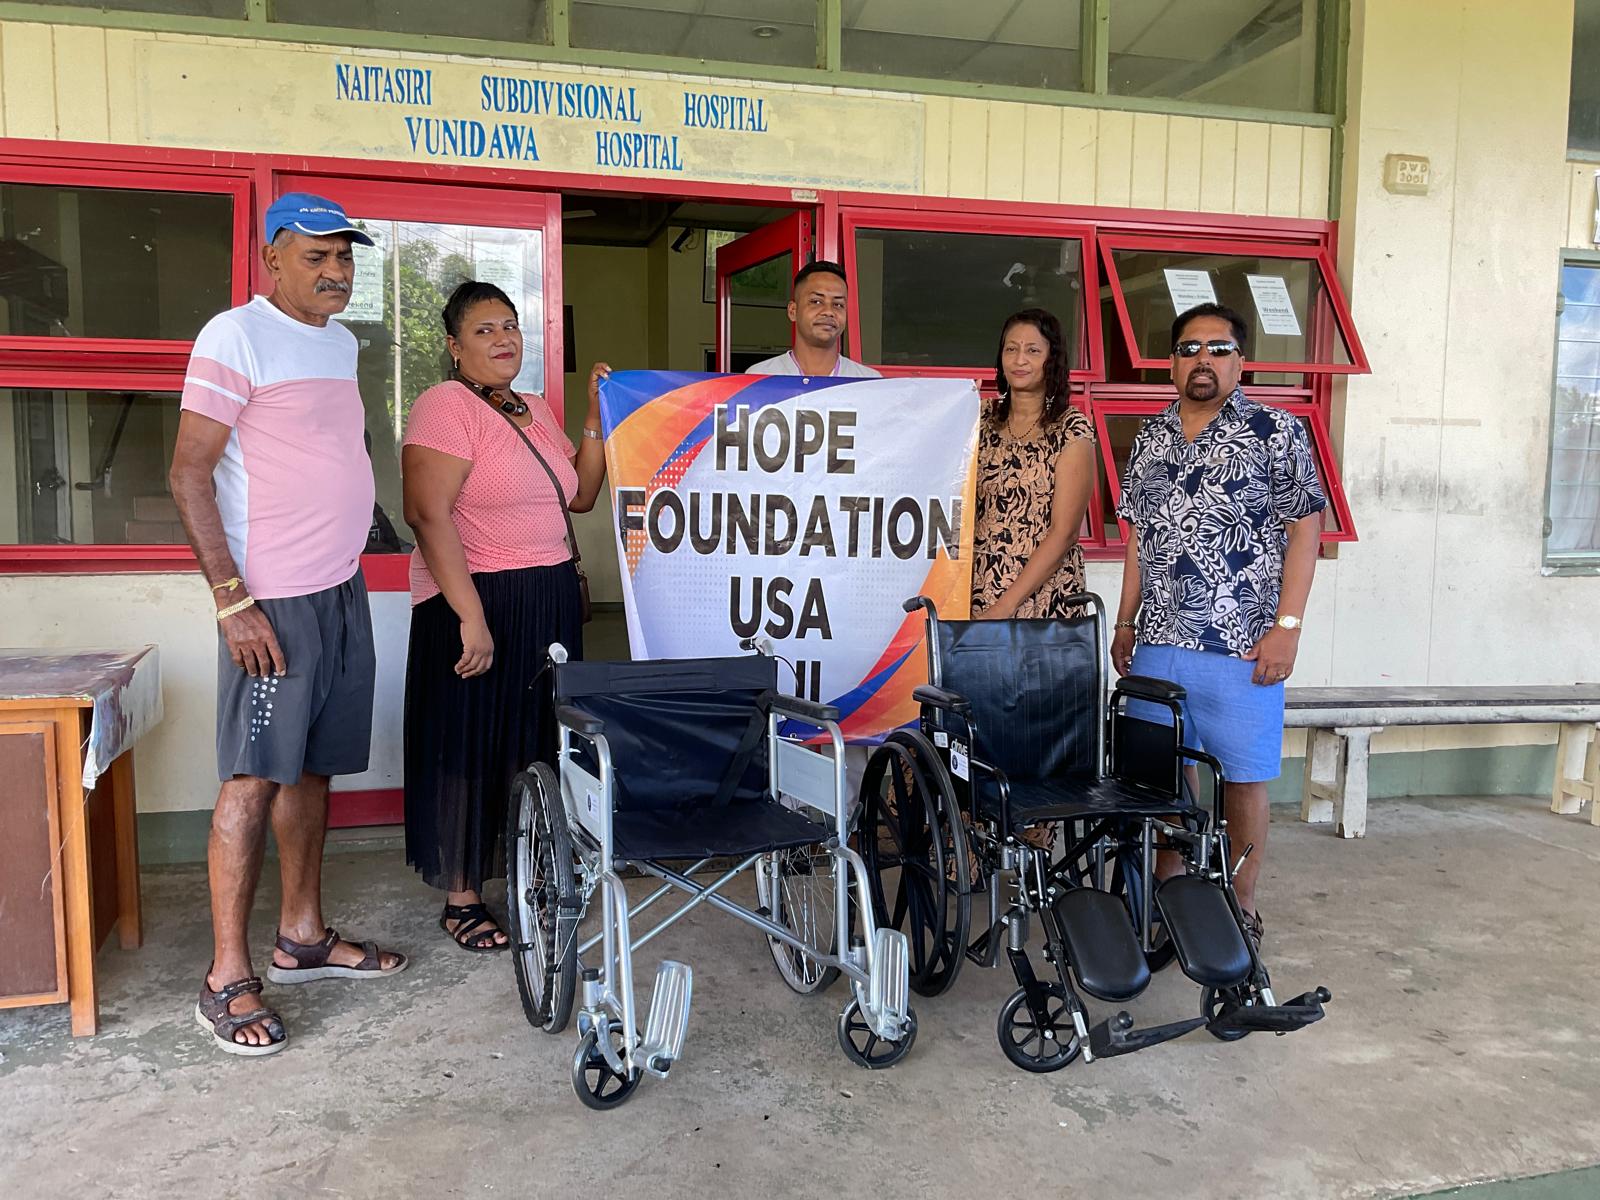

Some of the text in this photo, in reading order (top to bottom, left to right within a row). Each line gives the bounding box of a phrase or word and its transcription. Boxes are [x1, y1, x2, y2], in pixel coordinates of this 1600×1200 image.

[336, 63, 768, 132] NAITASIRI SUBDIVISIONAL HOSPITAL
[405, 117, 683, 171] VUNIDAWA HOSPITAL
[714, 404, 858, 475] HOPE
[617, 488, 962, 560] FOUNDATION
[729, 576, 833, 640] USA
